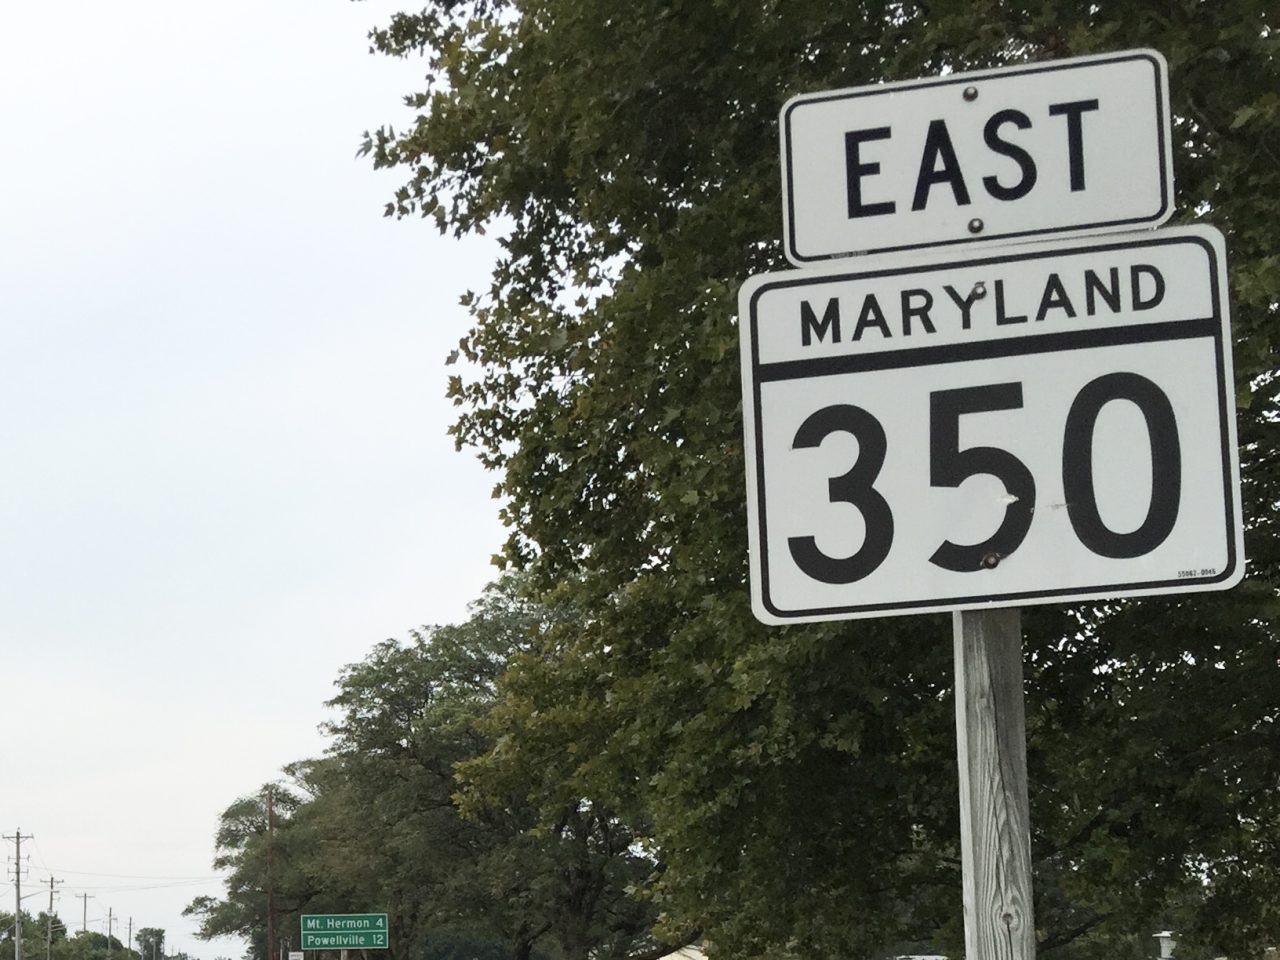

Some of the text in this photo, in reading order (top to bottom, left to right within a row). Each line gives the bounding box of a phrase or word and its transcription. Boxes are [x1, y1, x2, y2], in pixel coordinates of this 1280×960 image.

[844, 98, 1100, 220] EAST
[799, 263, 1166, 347] MARYLAND
[787, 371, 1182, 585] 350
[307, 917, 384, 929] Mt. Hermon 4
[307, 934, 384, 946] Powellville 12
